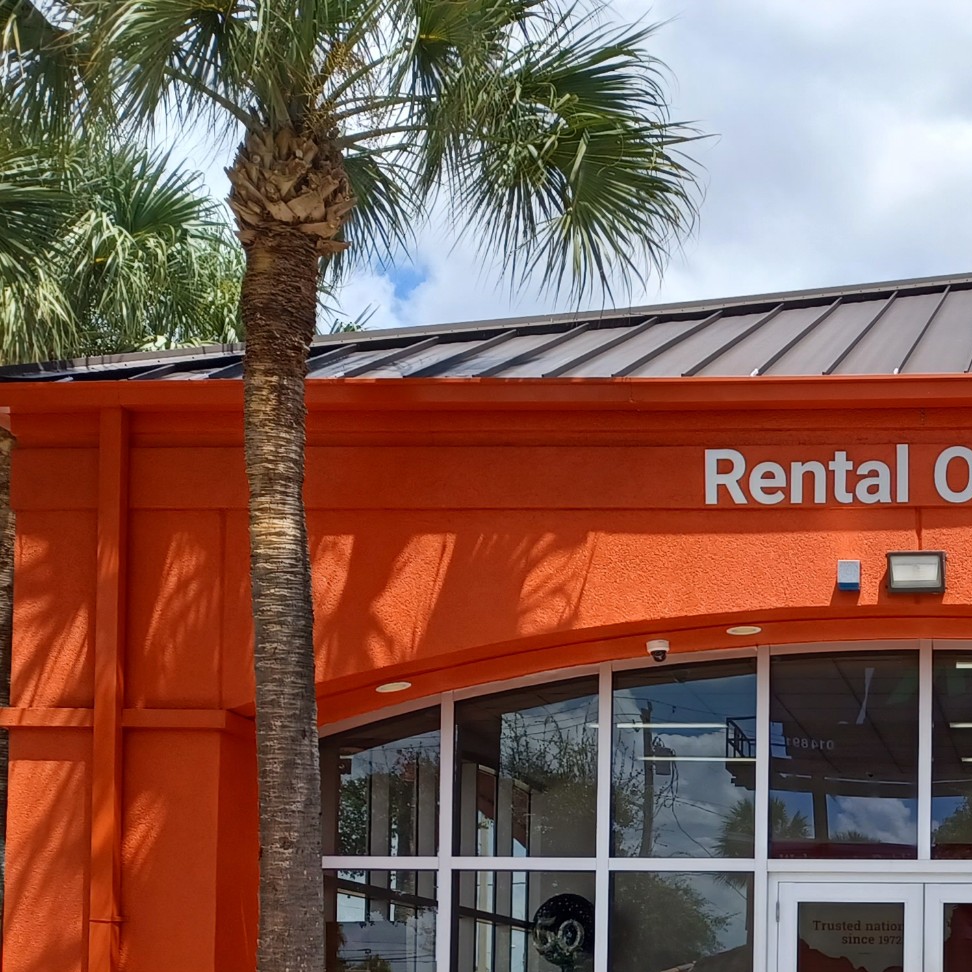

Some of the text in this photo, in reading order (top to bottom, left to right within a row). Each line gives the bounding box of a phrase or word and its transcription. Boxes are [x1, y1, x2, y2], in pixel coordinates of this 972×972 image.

[704, 444, 909, 505] Rental
[813, 920, 861, 932] Trusted
[841, 933, 903, 945] since 1972
